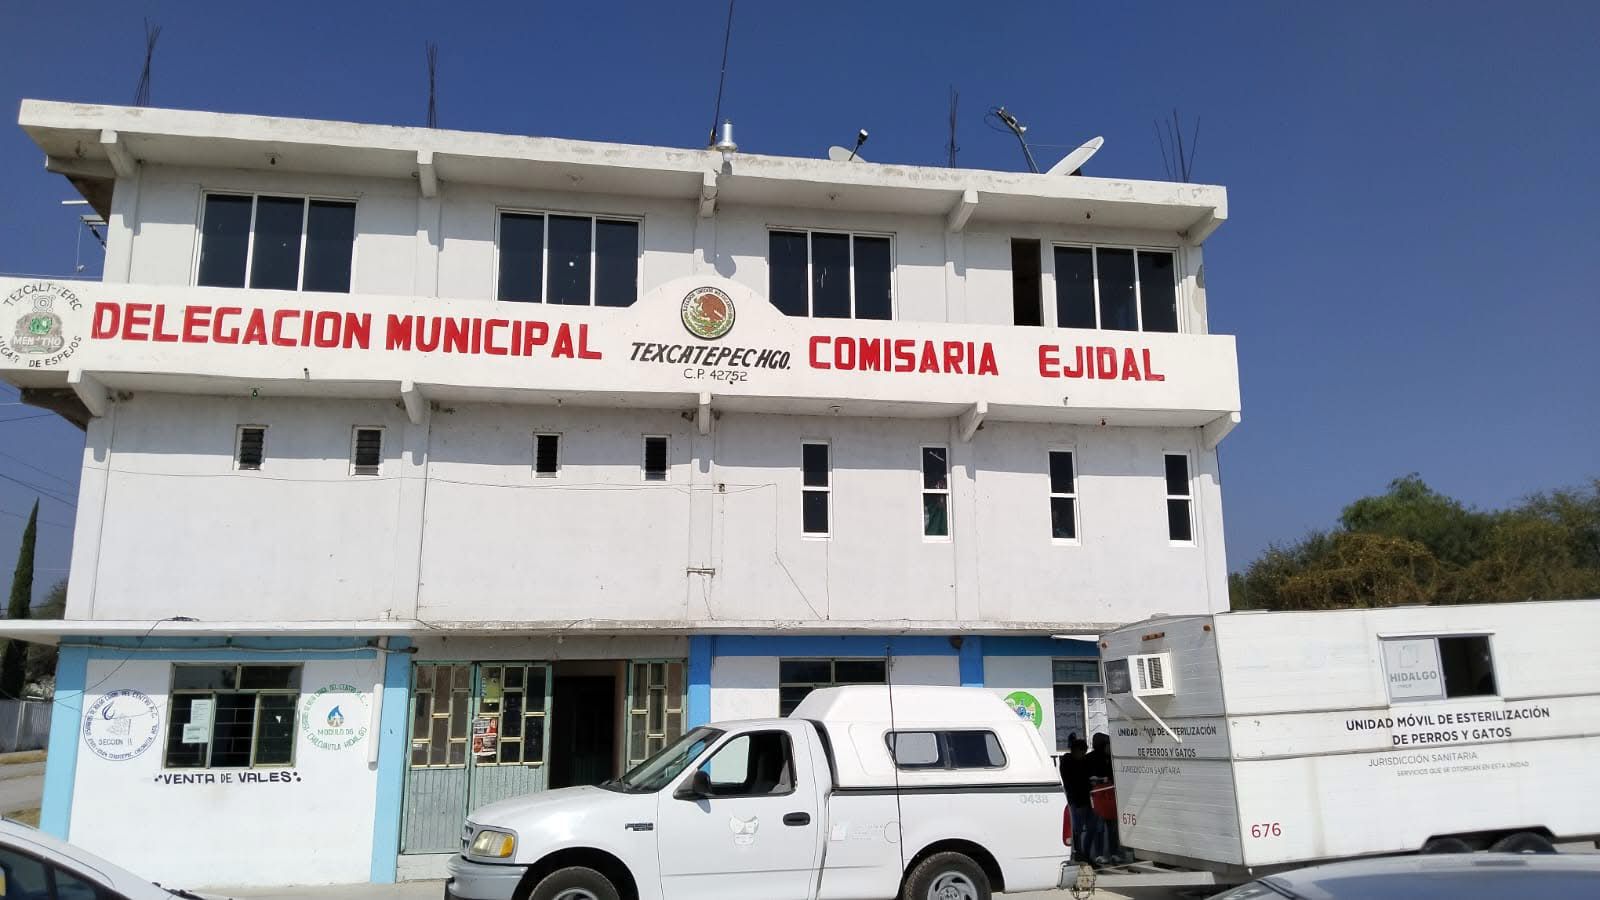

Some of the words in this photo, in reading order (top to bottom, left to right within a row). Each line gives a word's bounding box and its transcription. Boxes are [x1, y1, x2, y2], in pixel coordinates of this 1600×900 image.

[91, 302, 371, 349] DELEGACION
[385, 315, 602, 360] MUNICIPAL
[29, 359, 41, 367] DE
[45, 336, 82, 365] ESPEJOS
[631, 342, 757, 367] TEXCATEPEC
[755, 349, 791, 370] HGO.
[808, 335, 999, 376] COMISARIA
[1039, 344, 1165, 382] EJIDAL
[683, 368, 705, 379] C.P.
[709, 369, 748, 381] 42752
[1390, 671, 1437, 682] HIDALGO
[1346, 718, 1393, 731] UNIDAD
[1397, 714, 1435, 728] MÓVIL
[1438, 714, 1453, 725] DE
[1457, 705, 1550, 723] ESTERILIZACIÓN
[1118, 727, 1138, 736] UNIDAD
[1393, 734, 1408, 745] DE
[1412, 731, 1458, 744] PERROS
[1461, 730, 1468, 740] Y
[1473, 727, 1512, 739] GATOS
[1138, 748, 1145, 756] DE
[1147, 748, 1168, 757] PERROS
[1169, 748, 1174, 756] Y
[1175, 749, 1196, 758] GATOS
[1368, 754, 1429, 767] JURISDICCIÓN
[1432, 752, 1478, 762] SANITARIA
[164, 773, 215, 784] VENTA
[221, 773, 232, 783] DE
[238, 771, 292, 783] VALES
[1122, 813, 1137, 826] 676
[1251, 822, 1281, 838] 676
